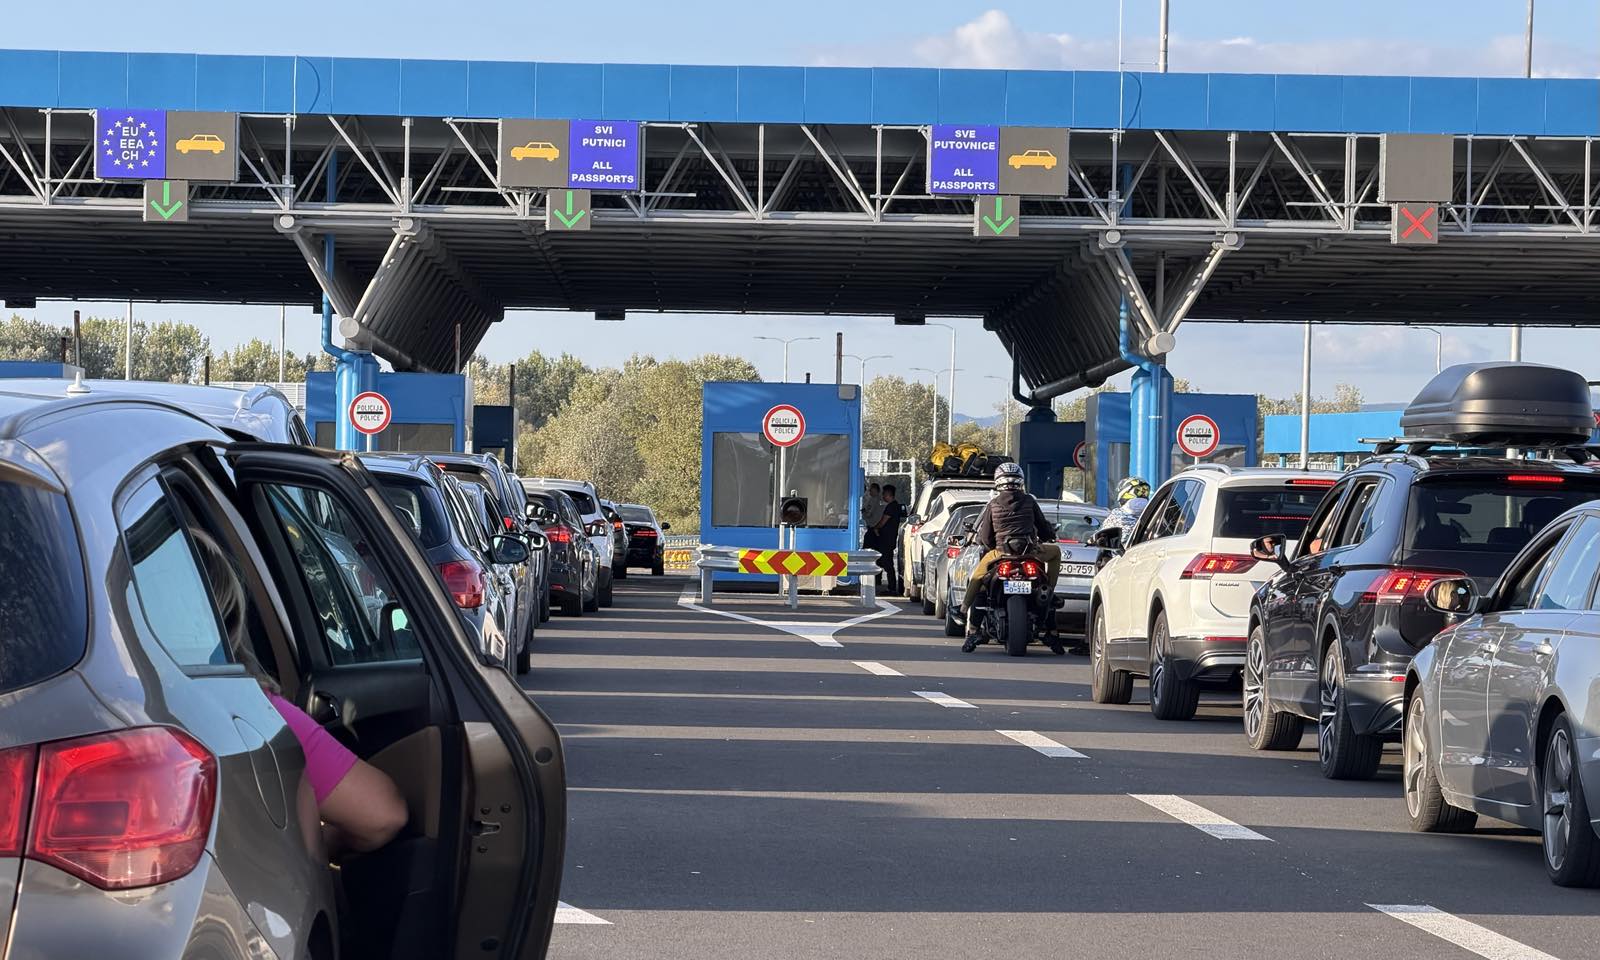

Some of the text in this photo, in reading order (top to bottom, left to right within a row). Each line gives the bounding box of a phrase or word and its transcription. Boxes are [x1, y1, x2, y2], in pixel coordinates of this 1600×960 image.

[122, 127, 139, 136] EU
[594, 126, 613, 134] SVI
[954, 130, 976, 138] SVE
[119, 139, 145, 149] EEA
[582, 138, 626, 148] PUTNICI
[934, 141, 996, 150] PUTOVNICE
[121, 151, 139, 160] CH
[592, 161, 613, 170] ALL
[953, 168, 974, 177] ALL
[571, 173, 635, 183] PASSPORTS
[932, 181, 996, 190] PASSPORTS
